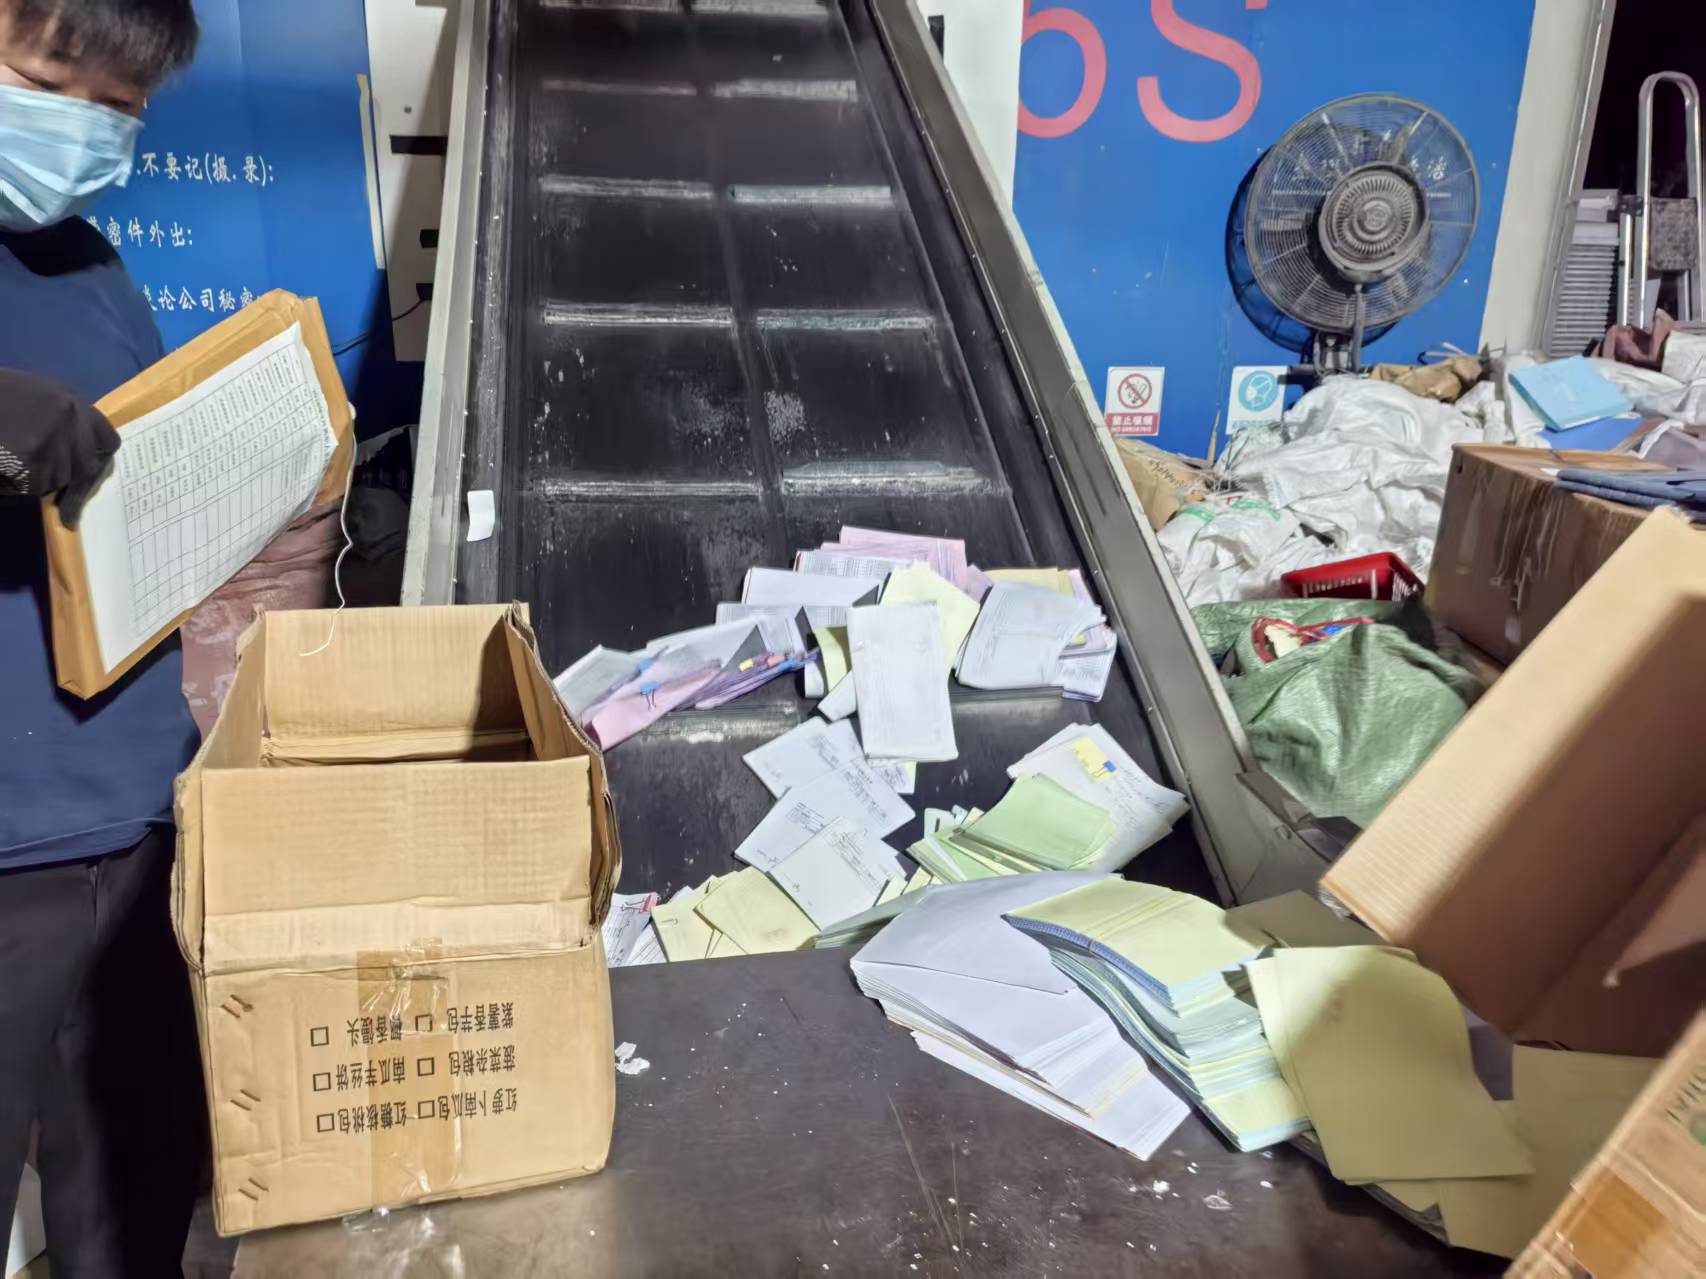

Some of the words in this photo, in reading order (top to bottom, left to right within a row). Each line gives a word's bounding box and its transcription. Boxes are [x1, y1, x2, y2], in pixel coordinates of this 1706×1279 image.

[446, 1001, 514, 1034] 紫薯香芋包
[335, 1055, 406, 1092] 南瓜芋丝饼
[448, 1044, 516, 1078] 菠菜杂粮包
[337, 1100, 407, 1135] 红糖核桃包
[437, 1087, 518, 1121] 红萝卜南瓜包
